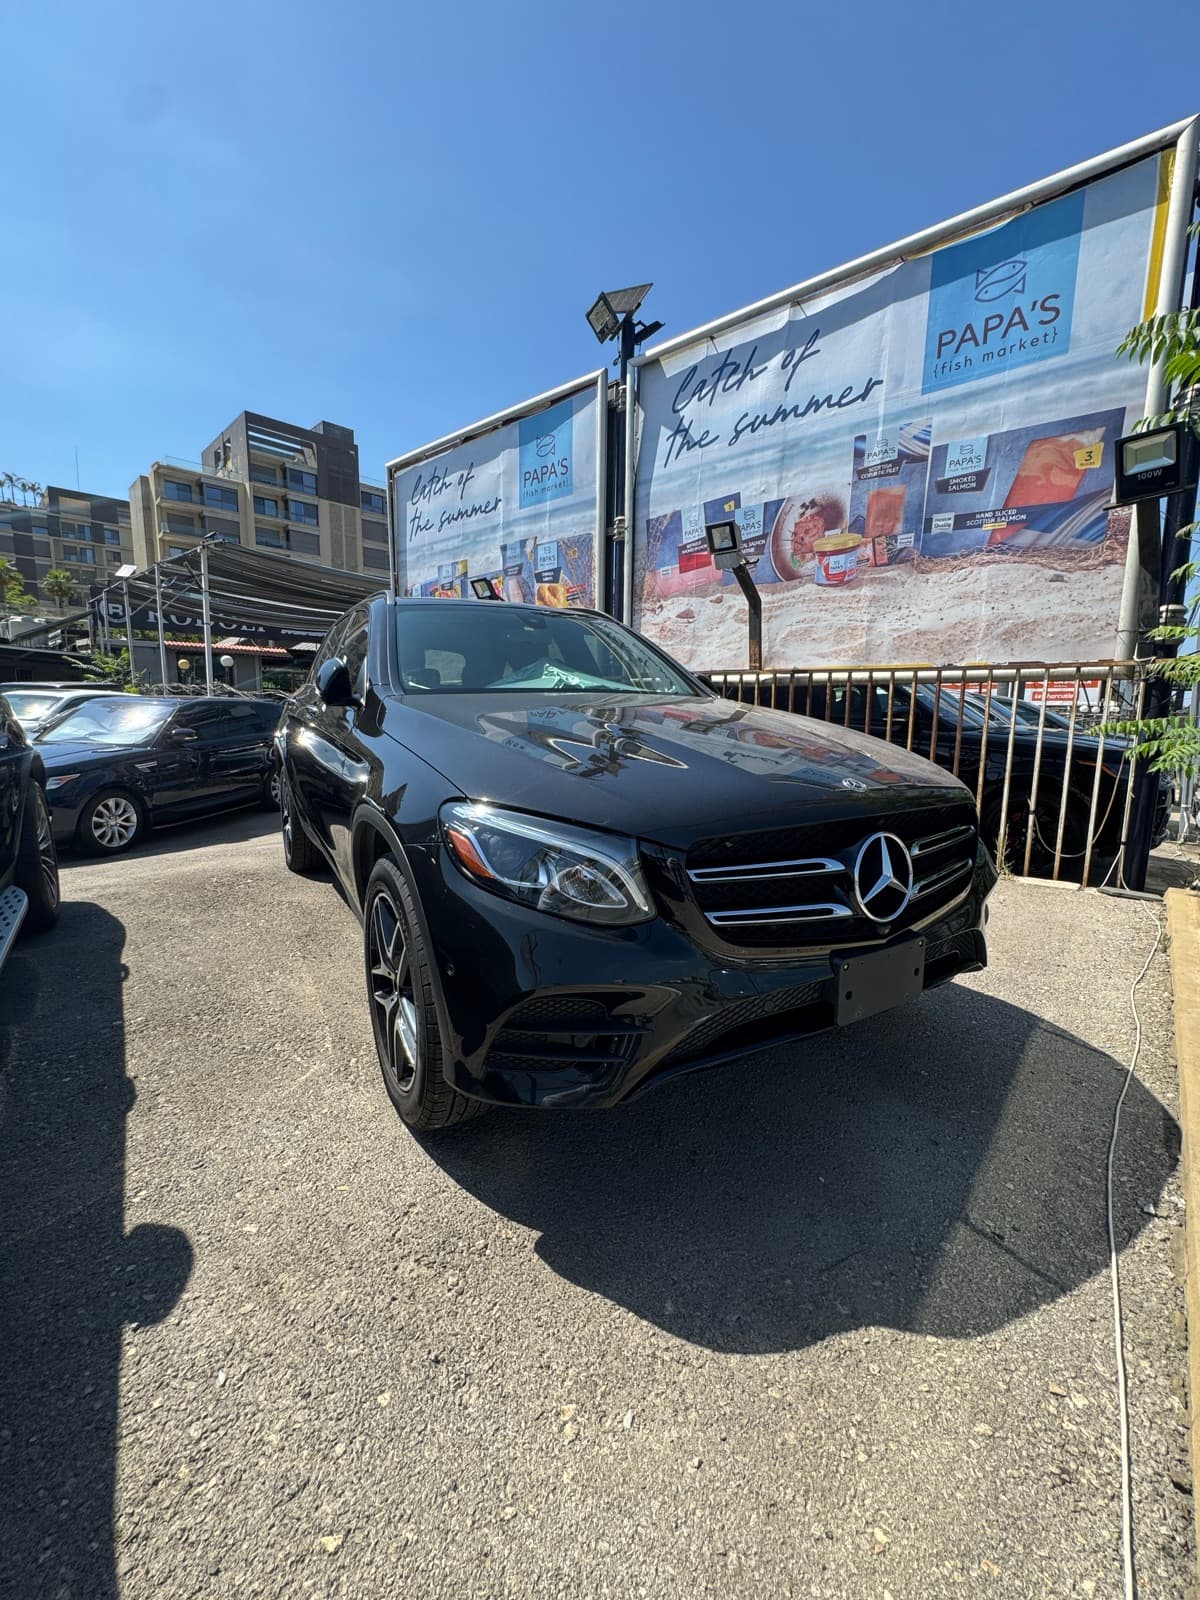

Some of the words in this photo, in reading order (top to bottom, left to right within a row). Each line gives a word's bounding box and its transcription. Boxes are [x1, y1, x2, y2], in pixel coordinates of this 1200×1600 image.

[937, 294, 1061, 359] PAPA'S
[933, 356, 973, 378] {fish
[982, 326, 1059, 362] market}
[671, 346, 768, 414] Catch
[781, 328, 821, 392] of
[664, 415, 720, 468] the
[728, 377, 884, 447] summer
[867, 447, 897, 460] PAPA'S
[949, 455, 981, 468] PAPA'S
[1085, 451, 1093, 461] 3
[523, 457, 569, 488] PAPA'S
[949, 475, 976, 485] SMOKED
[1137, 469, 1163, 480] 100W
[411, 465, 452, 506] Catch
[458, 462, 475, 500] of
[948, 482, 976, 491] SALMON
[409, 508, 434, 543] the
[438, 497, 502, 532] summer
[997, 514, 1027, 523] SALMON
